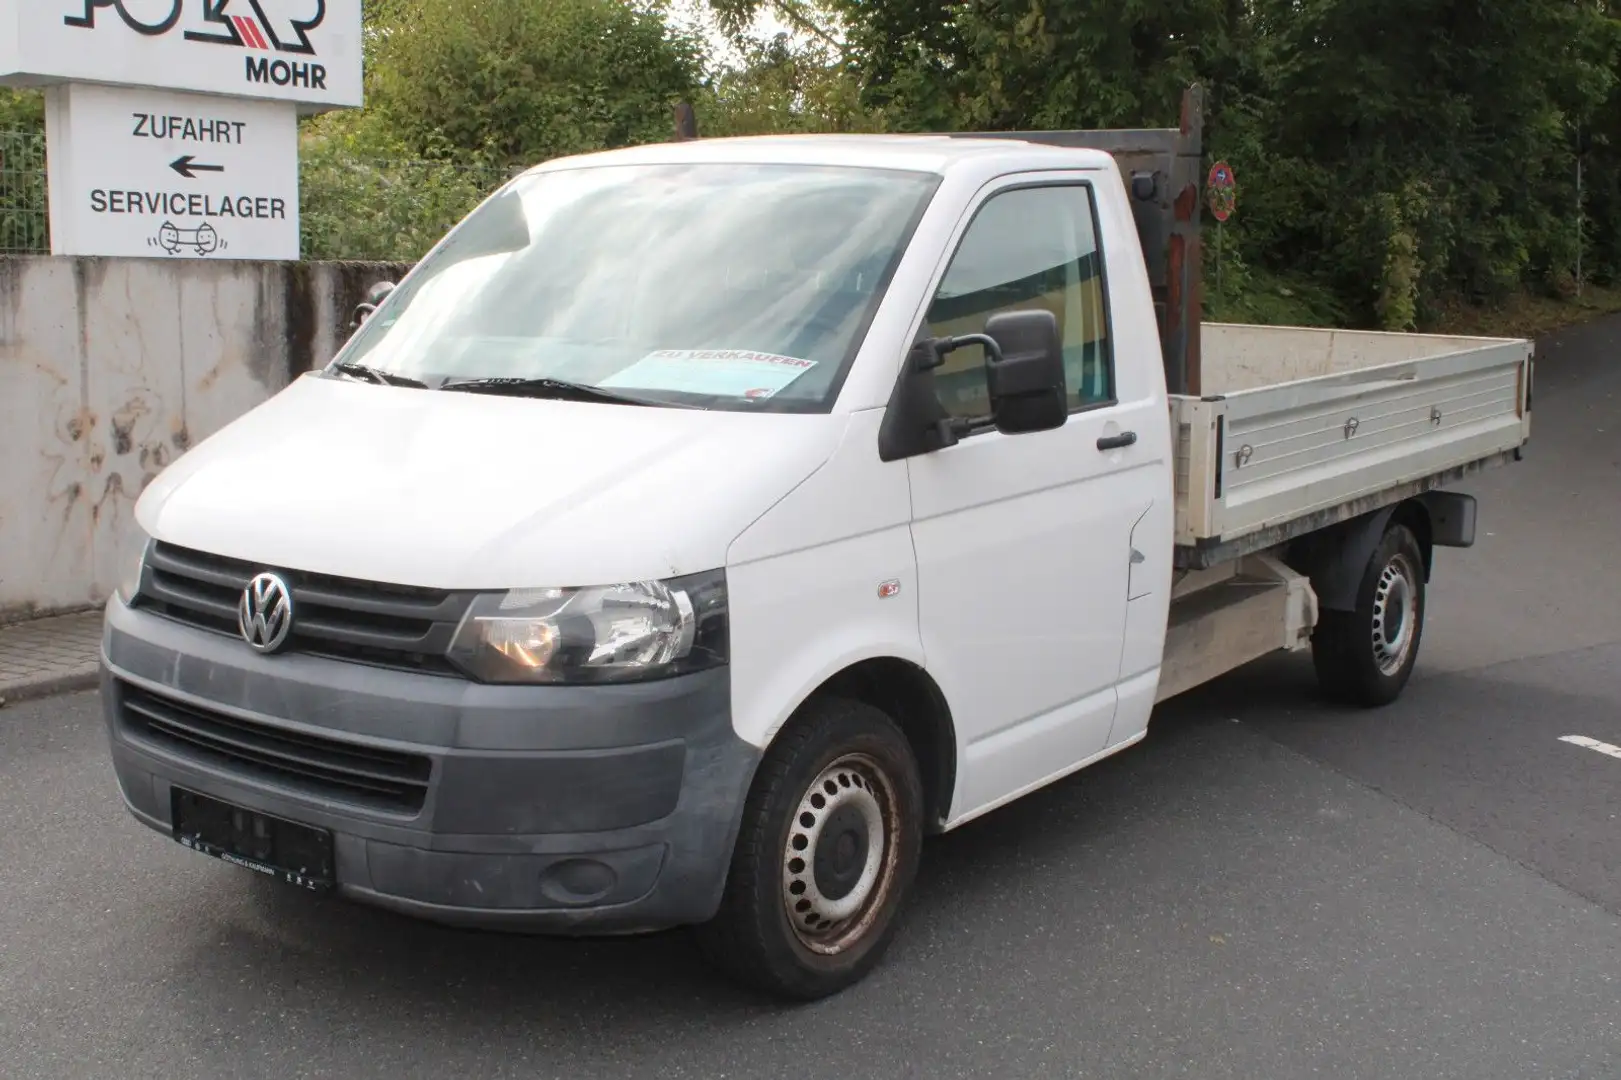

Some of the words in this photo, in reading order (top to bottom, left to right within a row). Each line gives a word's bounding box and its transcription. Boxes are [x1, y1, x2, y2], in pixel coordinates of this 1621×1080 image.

[245, 56, 327, 90] MOHR
[132, 113, 246, 145] ZUFAHRT
[91, 189, 286, 219] SERVICELAGER
[654, 350, 681, 358] ZU
[688, 350, 812, 368] VERKAUFEN
